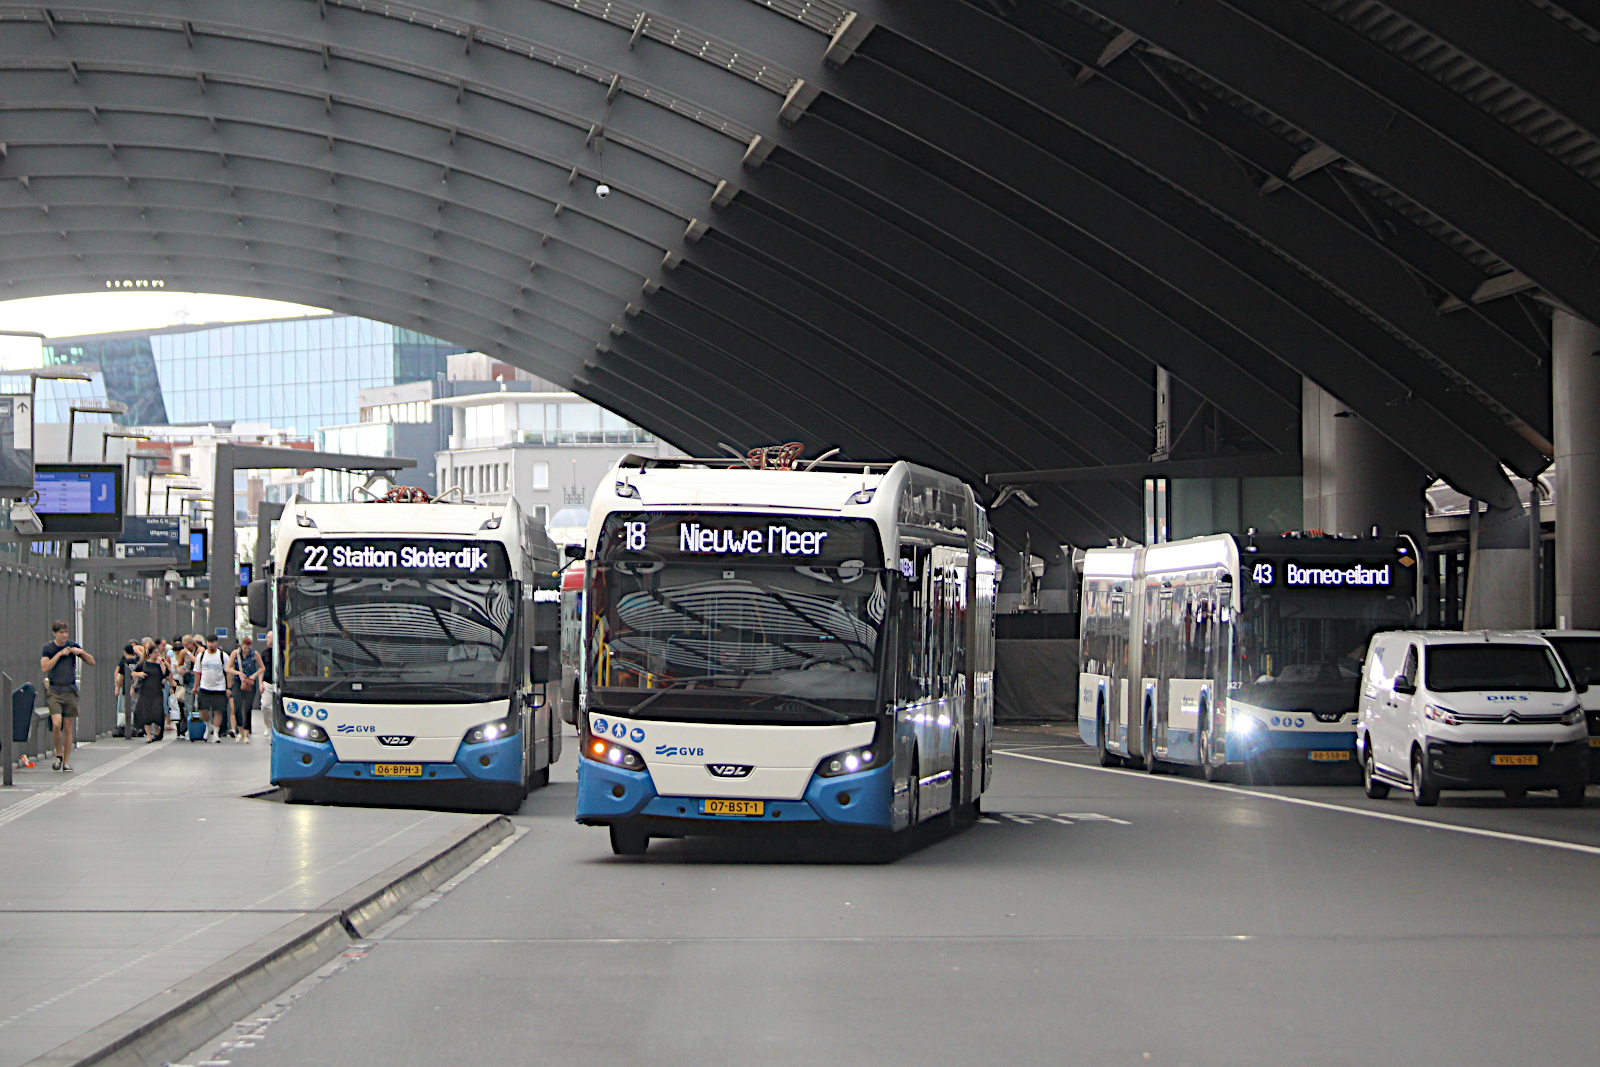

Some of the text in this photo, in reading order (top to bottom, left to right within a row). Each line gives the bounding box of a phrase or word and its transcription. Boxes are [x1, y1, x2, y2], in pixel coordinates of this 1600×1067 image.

[97, 483, 107, 501] J
[623, 521, 828, 555] 18 Nieuwe Meer
[190, 544, 199, 553] H
[303, 545, 488, 573] 22 Station Sloterdijk
[240, 572, 248, 582] G
[1252, 563, 1390, 585] 43 Borneo-eiland
[355, 725, 376, 733] GVB
[381, 736, 409, 745] VDL
[679, 747, 704, 756] GVB
[377, 765, 420, 774] 06-BPH-3
[712, 765, 747, 776] VDL
[710, 801, 758, 813] 07-BST-1
